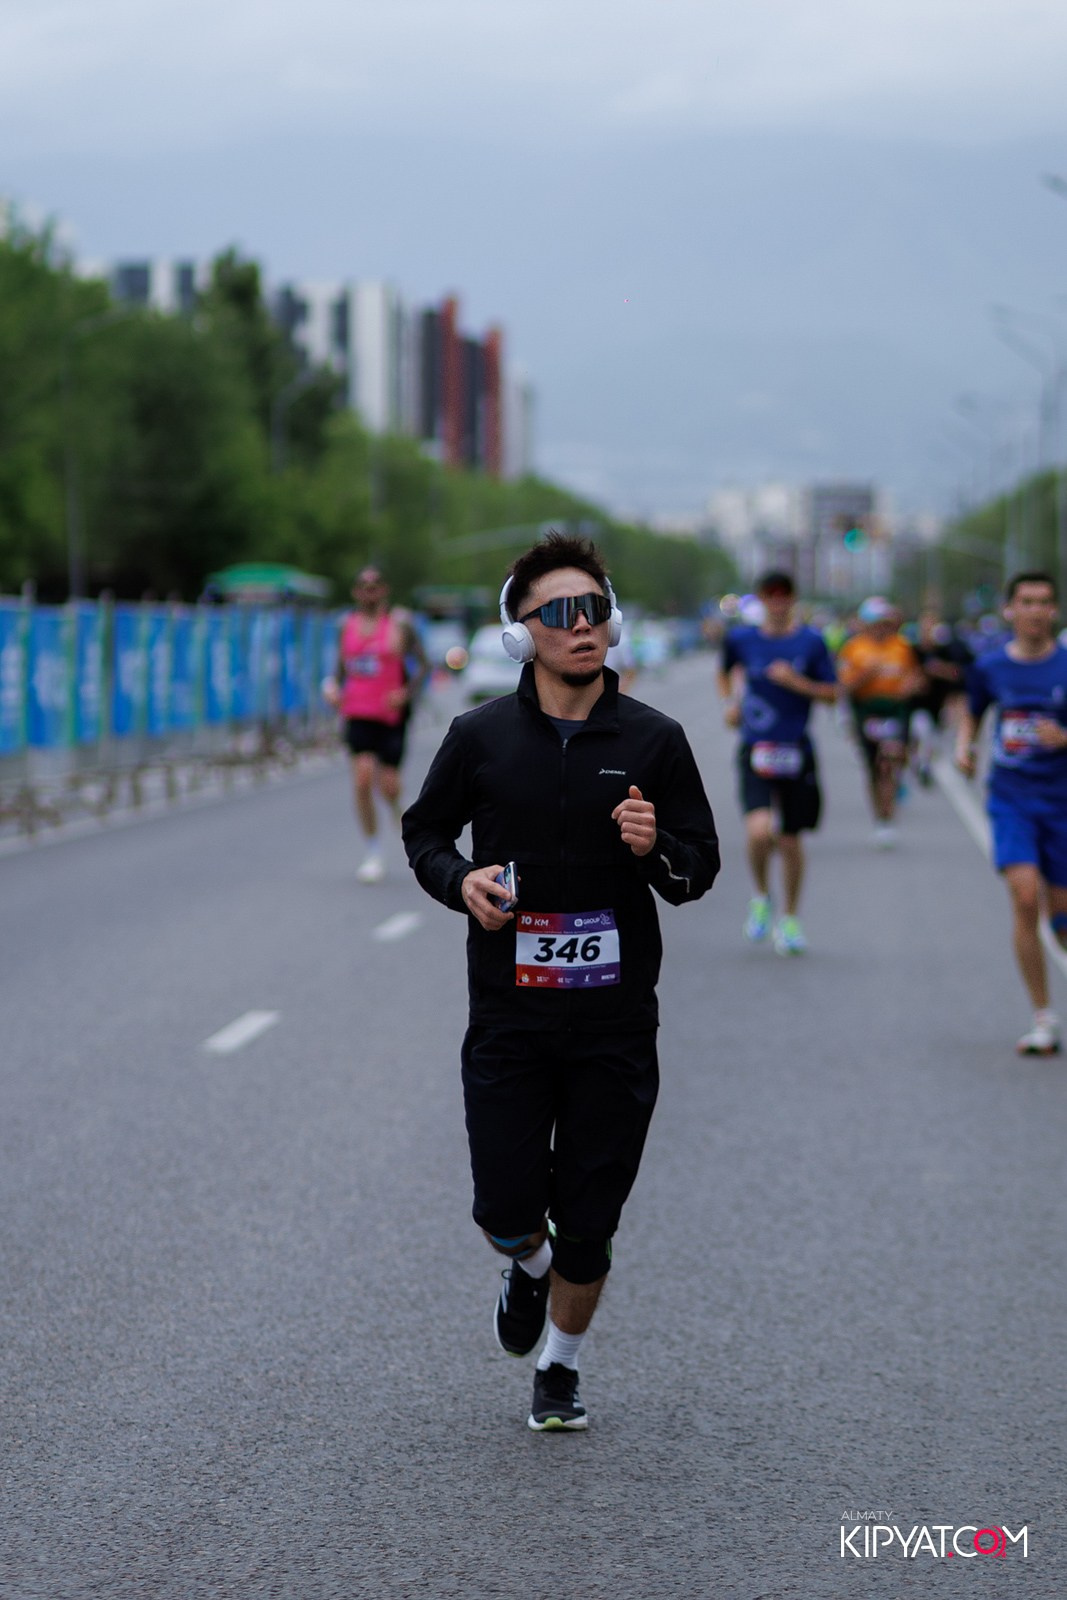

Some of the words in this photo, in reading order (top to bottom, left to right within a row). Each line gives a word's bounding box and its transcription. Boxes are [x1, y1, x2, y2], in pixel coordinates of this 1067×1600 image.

[521, 915, 532, 925] 10
[534, 918, 549, 927] KM
[533, 935, 602, 963] 346
